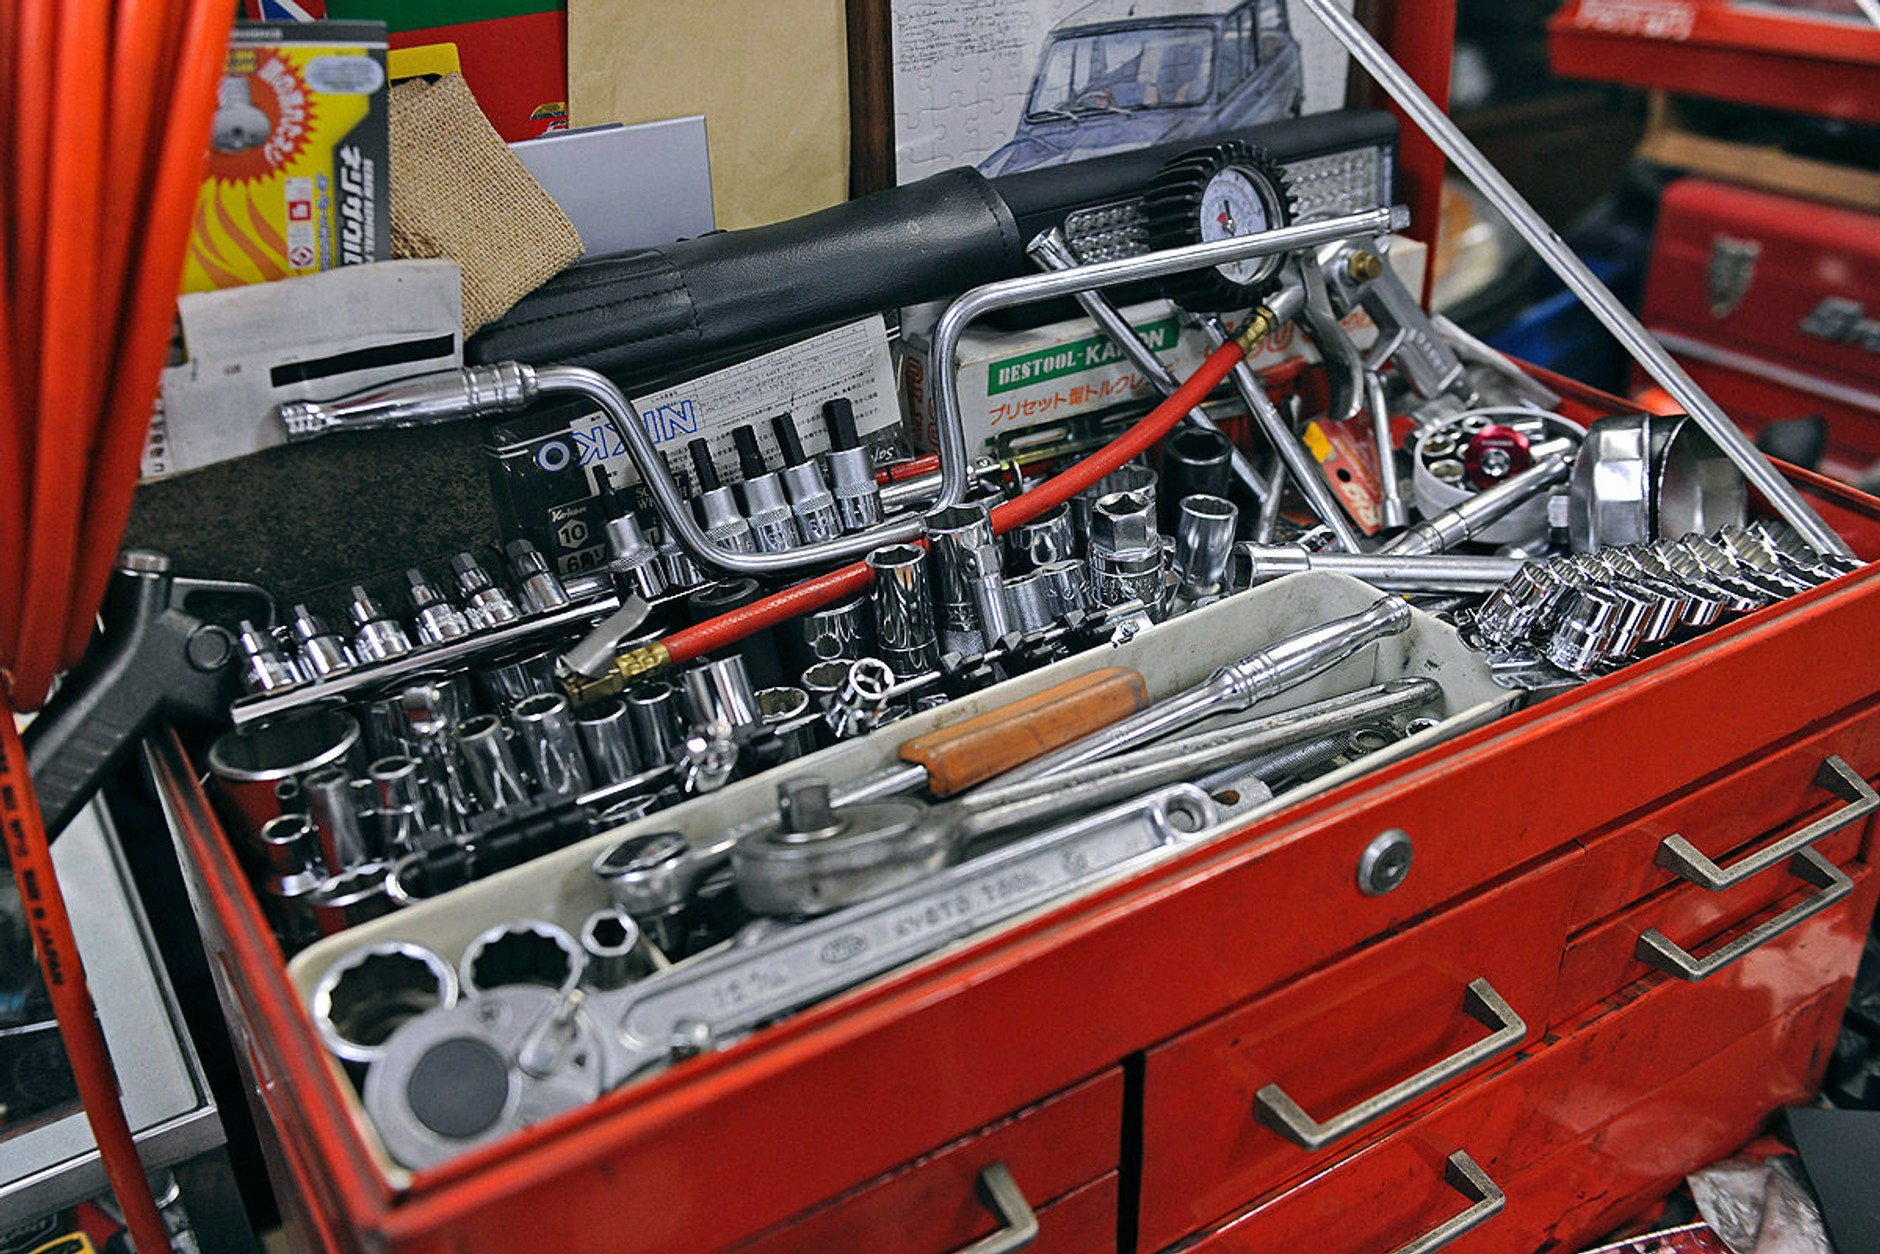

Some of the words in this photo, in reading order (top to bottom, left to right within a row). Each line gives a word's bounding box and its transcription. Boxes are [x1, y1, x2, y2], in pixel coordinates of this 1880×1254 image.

[340, 145, 363, 265] ネジザウル
[989, 364, 1172, 425] プリセット型トルクレ
[538, 399, 698, 473] NIKO
[560, 525, 586, 546] 10
